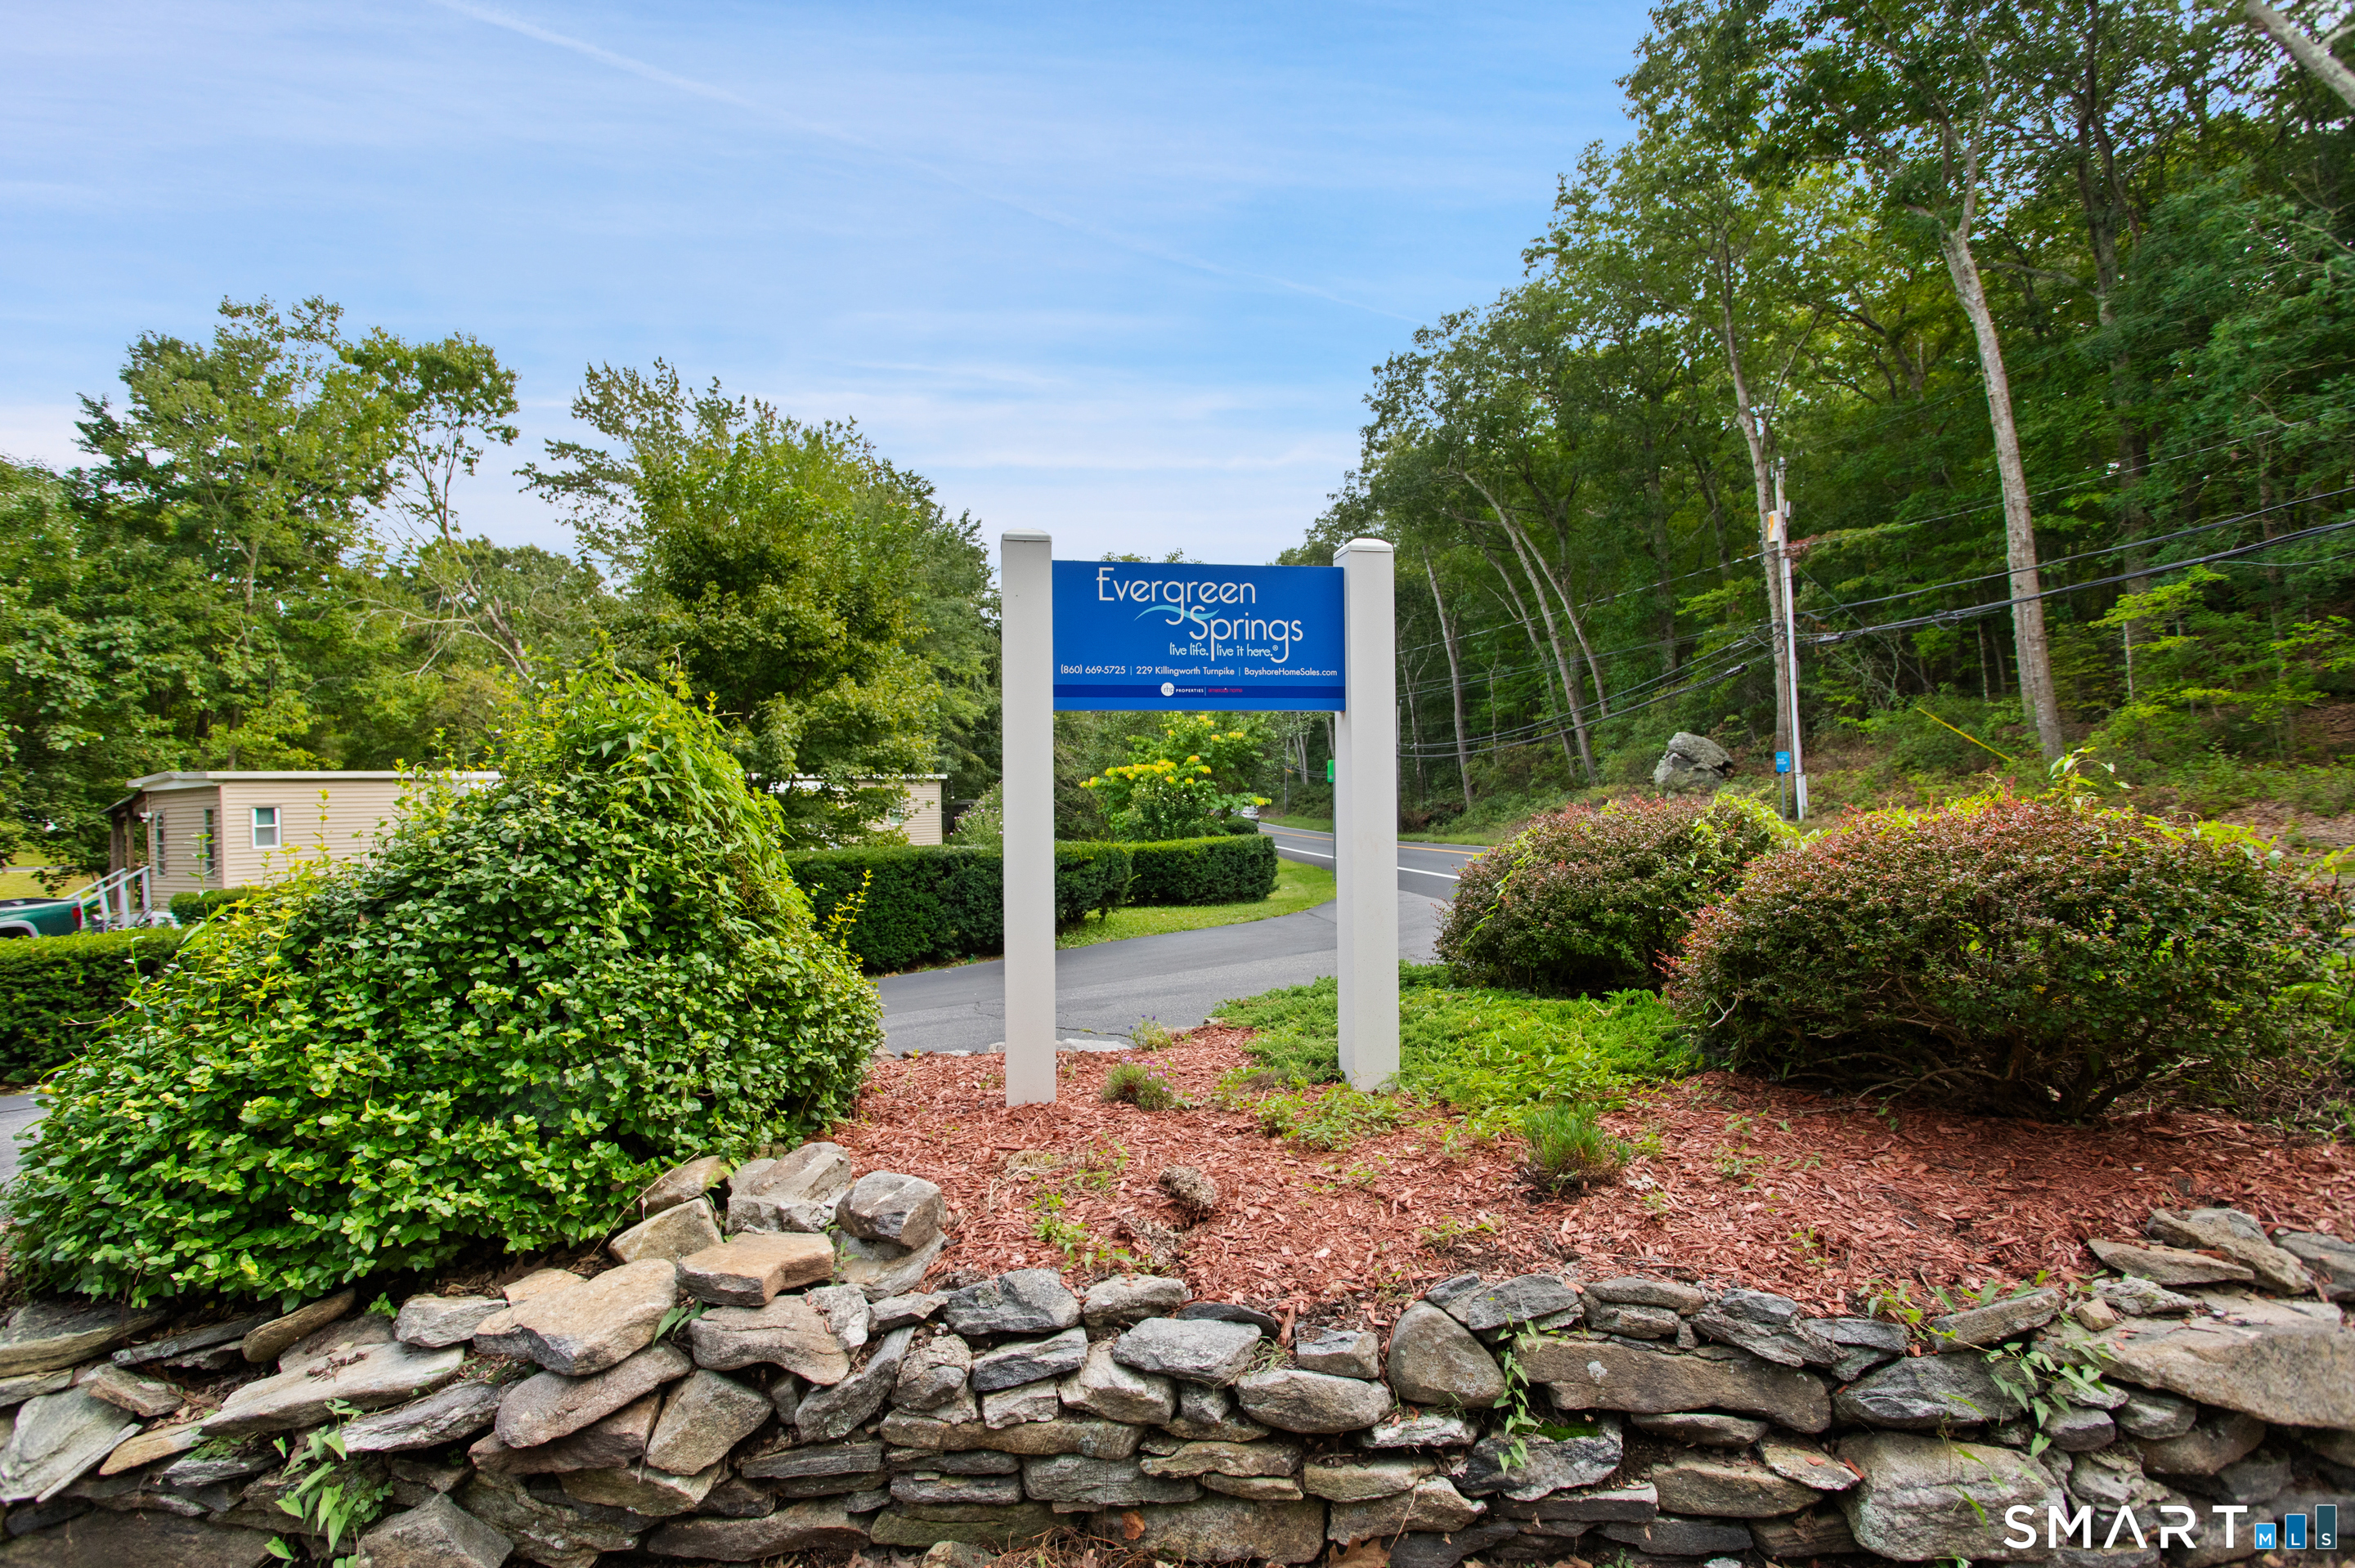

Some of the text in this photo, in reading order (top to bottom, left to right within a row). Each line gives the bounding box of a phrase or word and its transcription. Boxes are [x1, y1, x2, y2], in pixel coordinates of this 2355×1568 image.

[1096, 567, 1256, 625] Evergreen
[1169, 642, 1187, 656] live
[1190, 642, 1209, 656] life.
[1216, 643, 1234, 656] live
[1236, 645, 1245, 656] it
[1189, 605, 1303, 663] Springs
[1061, 664, 1338, 678] (860) 669-5725 229 Killingworth Turnpike BayshoreHomeSales.com
